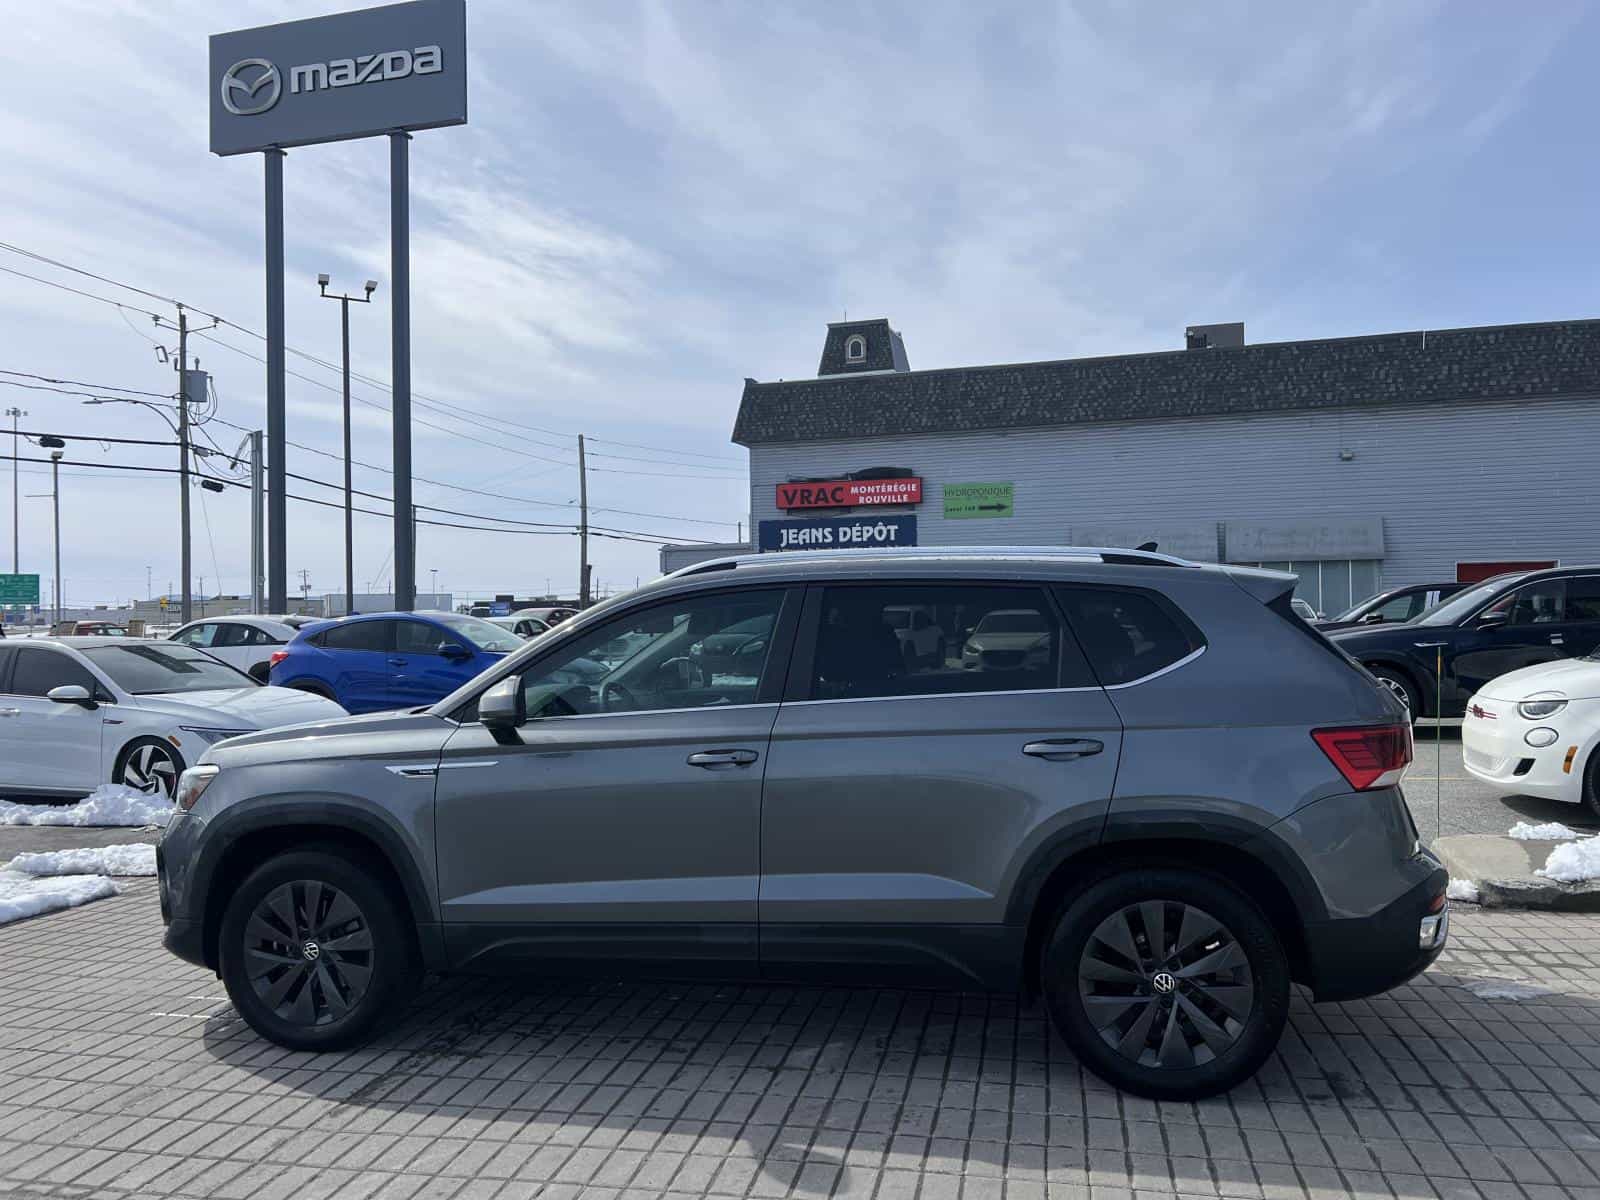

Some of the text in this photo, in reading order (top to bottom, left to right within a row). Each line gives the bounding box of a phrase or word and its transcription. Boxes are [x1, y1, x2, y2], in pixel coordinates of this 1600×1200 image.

[783, 486, 844, 506] VRAC
[850, 482, 917, 495] MONTÉRÉGIE
[858, 494, 909, 504] ROUVILLE
[780, 522, 899, 547] JEANS DÉPÔT
